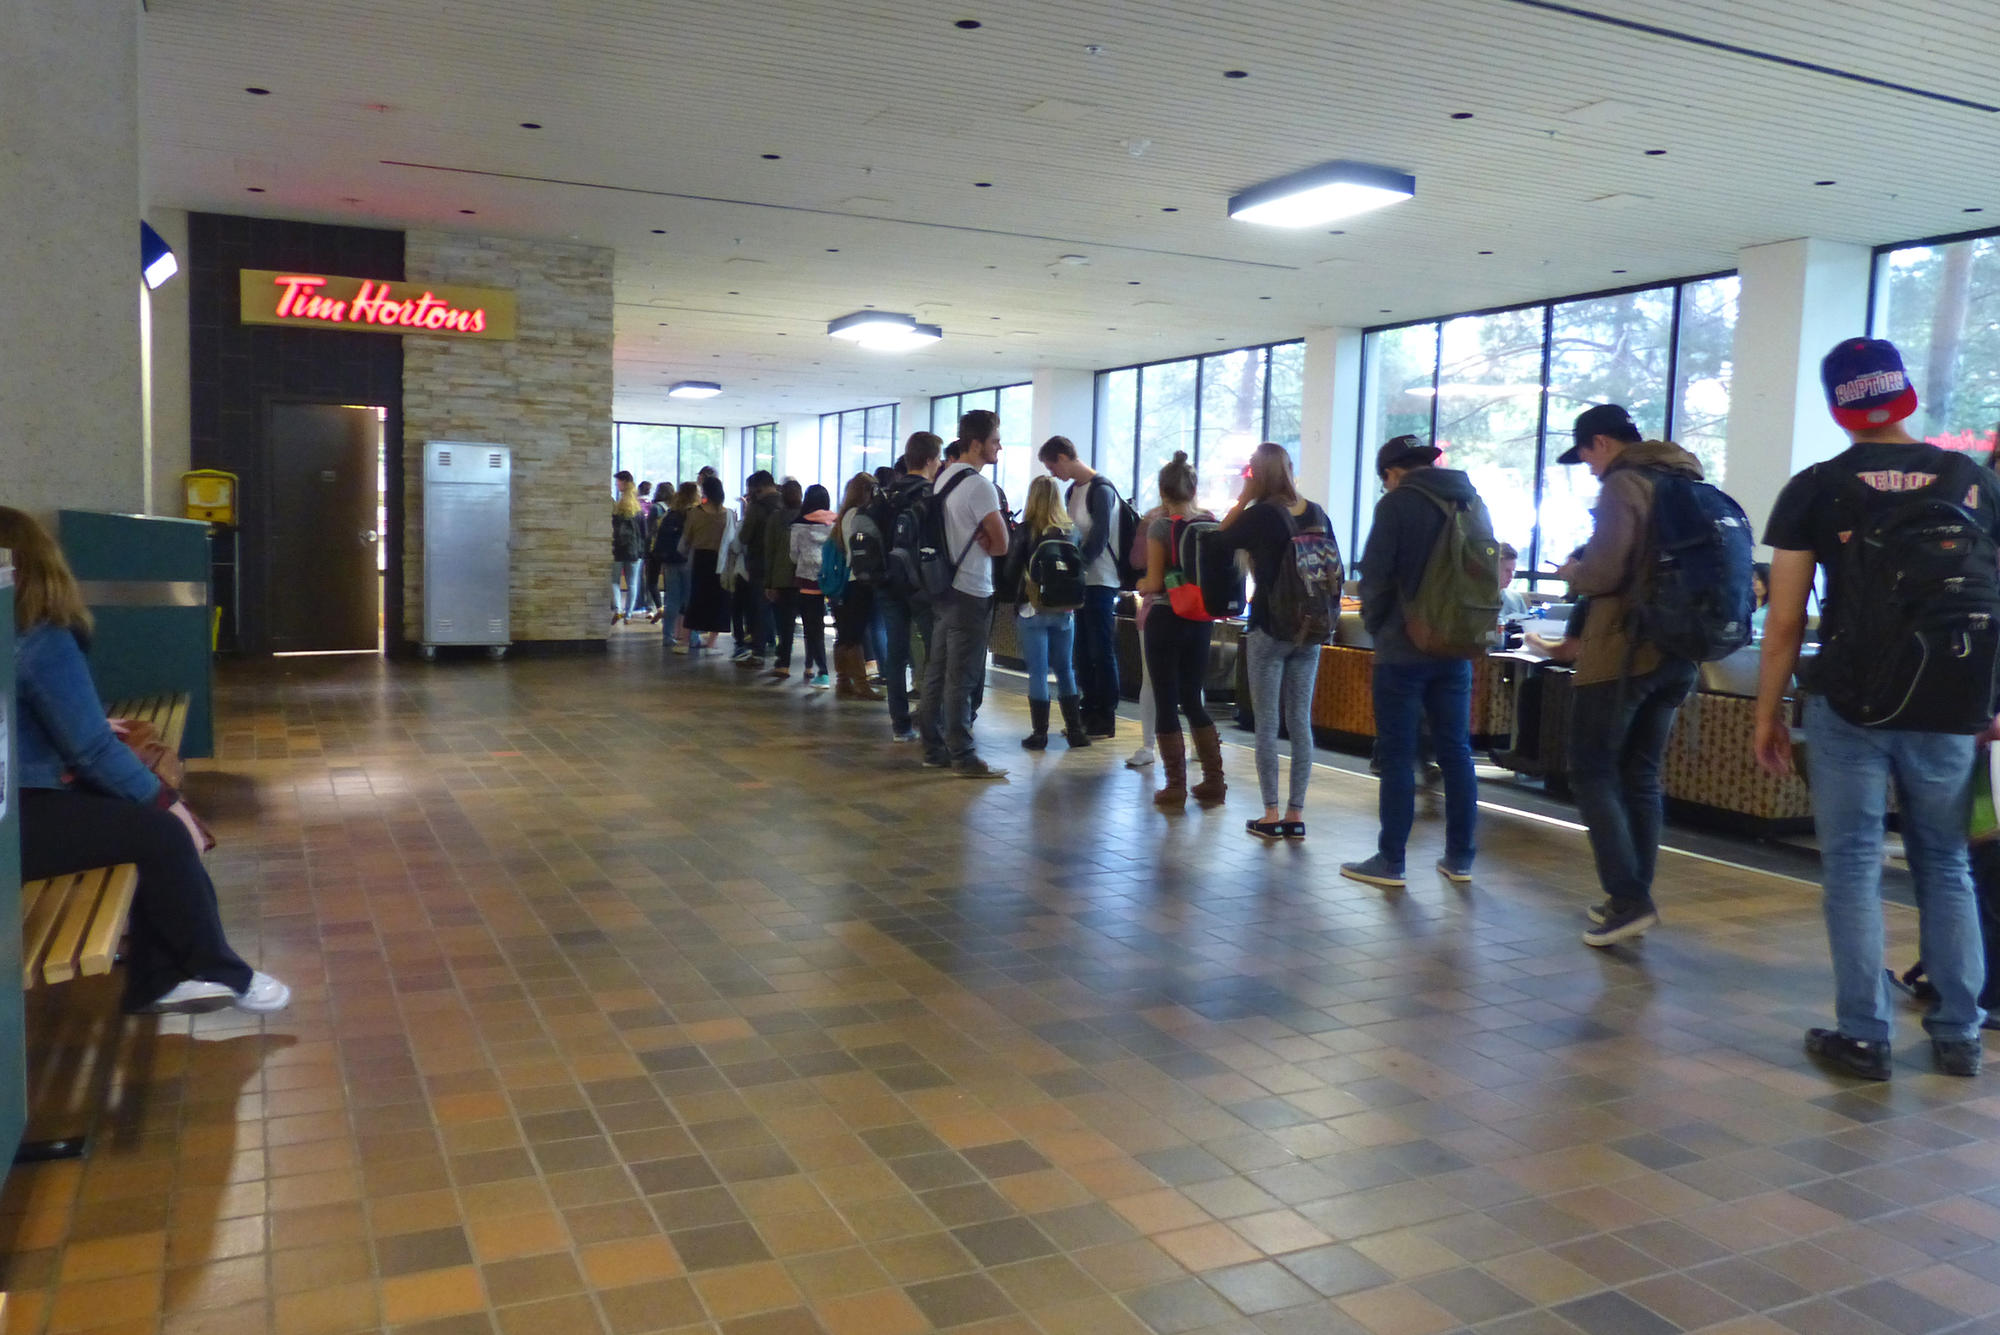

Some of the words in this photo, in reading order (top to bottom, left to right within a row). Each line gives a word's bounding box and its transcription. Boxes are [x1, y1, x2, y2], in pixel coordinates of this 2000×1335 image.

[274, 275, 347, 322] Tim
[349, 279, 486, 332] Hortons
[1835, 371, 1904, 406] RAPTORS
